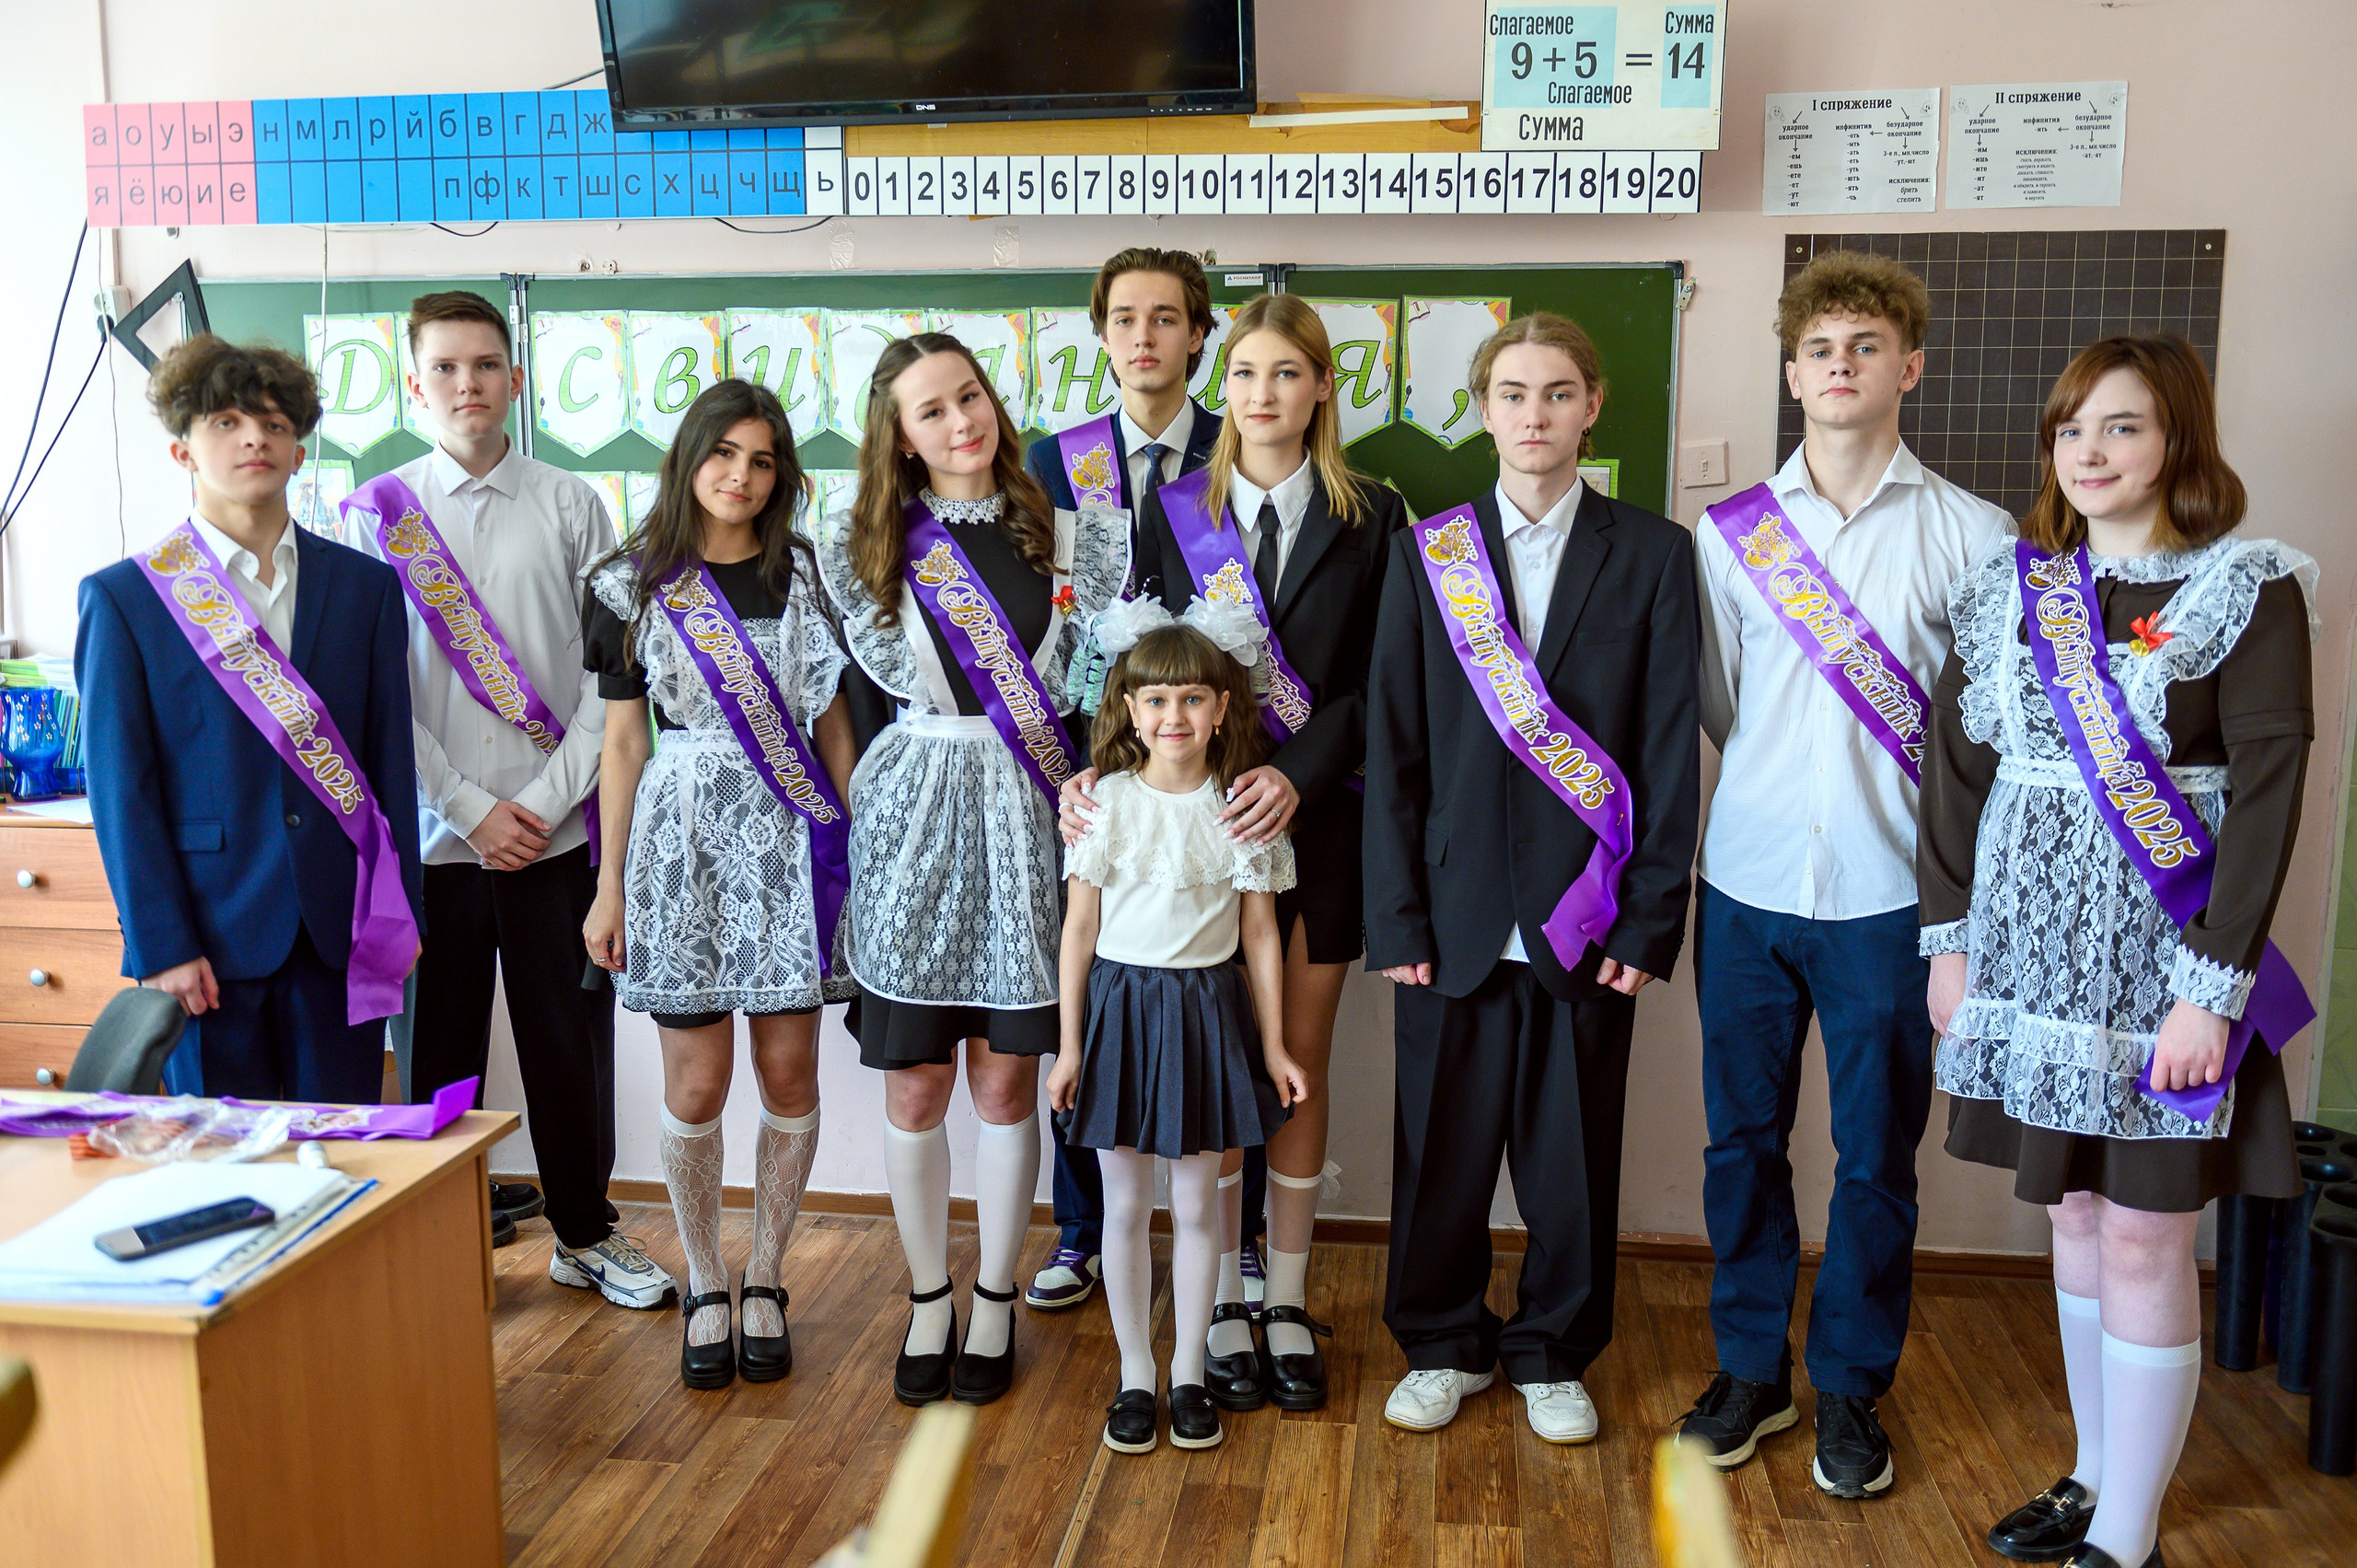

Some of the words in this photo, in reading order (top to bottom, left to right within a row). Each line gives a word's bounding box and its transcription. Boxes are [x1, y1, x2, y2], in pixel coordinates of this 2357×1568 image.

[1490, 15, 1573, 35] Слагаемое
[1666, 11, 1713, 33] Сумма
[1512, 42, 1532, 79] 9
[1575, 41, 1596, 78] 5
[1668, 42, 1704, 78] 14
[1549, 82, 1631, 103] Слагаемое
[1820, 99, 1892, 111] спряжение
[1995, 92, 2004, 104] II
[2008, 91, 2082, 104] спряжение
[92, 126, 107, 145] а
[126, 125, 142, 145] о
[160, 124, 174, 150] у
[192, 124, 212, 144] ы
[228, 122, 243, 143] э
[263, 122, 278, 142] н
[296, 120, 316, 139] м
[332, 120, 350, 140] л
[370, 118, 385, 145] р
[407, 110, 423, 138] й
[439, 109, 457, 137] б
[477, 117, 493, 136] в
[516, 115, 526, 134] г
[547, 114, 566, 139] д
[584, 113, 607, 134] ж
[1519, 114, 1583, 140] Сумма
[1835, 122, 1872, 131] инфинитив
[1968, 118, 1996, 126] ударное
[2023, 117, 2061, 125] инфинитив
[2075, 114, 2112, 122] безударное
[95, 187, 109, 205] я
[130, 179, 145, 204] ё
[162, 185, 182, 204] ю
[198, 185, 212, 203] и
[230, 182, 245, 202] е
[445, 179, 459, 198] п
[474, 170, 500, 204] ф
[517, 178, 530, 197] к
[553, 177, 568, 196] т
[586, 176, 610, 195] ш
[625, 174, 641, 195] с
[663, 174, 679, 194] х
[701, 174, 719, 199] ц
[739, 172, 755, 192] ч
[773, 171, 800, 198] щ
[818, 171, 833, 192] ь
[855, 172, 869, 201] 0
[886, 172, 897, 200] 1
[918, 172, 934, 200] 2
[952, 171, 967, 200] 3
[982, 171, 1000, 200] 4
[1018, 171, 1034, 199] 5
[1051, 170, 1067, 200] 6
[1085, 171, 1100, 199] 7
[1120, 170, 1135, 199] 8
[1153, 170, 1168, 199] 9
[1183, 169, 1218, 199] 10
[1231, 169, 1262, 199] 11
[1276, 169, 1312, 198] 12
[1322, 168, 1359, 198] 13
[1370, 168, 1407, 198] 14
[1415, 168, 1453, 198] 15
[1464, 168, 1501, 198] 16
[1512, 168, 1550, 198] 17
[1559, 168, 1596, 198] 18
[1607, 168, 1644, 198] 19
[1655, 168, 1695, 198] 20
[1900, 186, 1918, 194] брить
[407, 553, 528, 723] Выпускник
[1768, 562, 1923, 742] Выпускник
[171, 571, 315, 749] Выпускник
[296, 737, 365, 815] 2025
[936, 581, 1047, 744] Выпускница
[1024, 734, 1077, 788] 202
[1440, 562, 1550, 745] Выпускник
[1528, 733, 1615, 810] 2025
[683, 607, 792, 770] Выпускница
[772, 764, 841, 825] 2025
[2036, 587, 2133, 794] Выпускница
[2105, 779, 2200, 868] 2025
